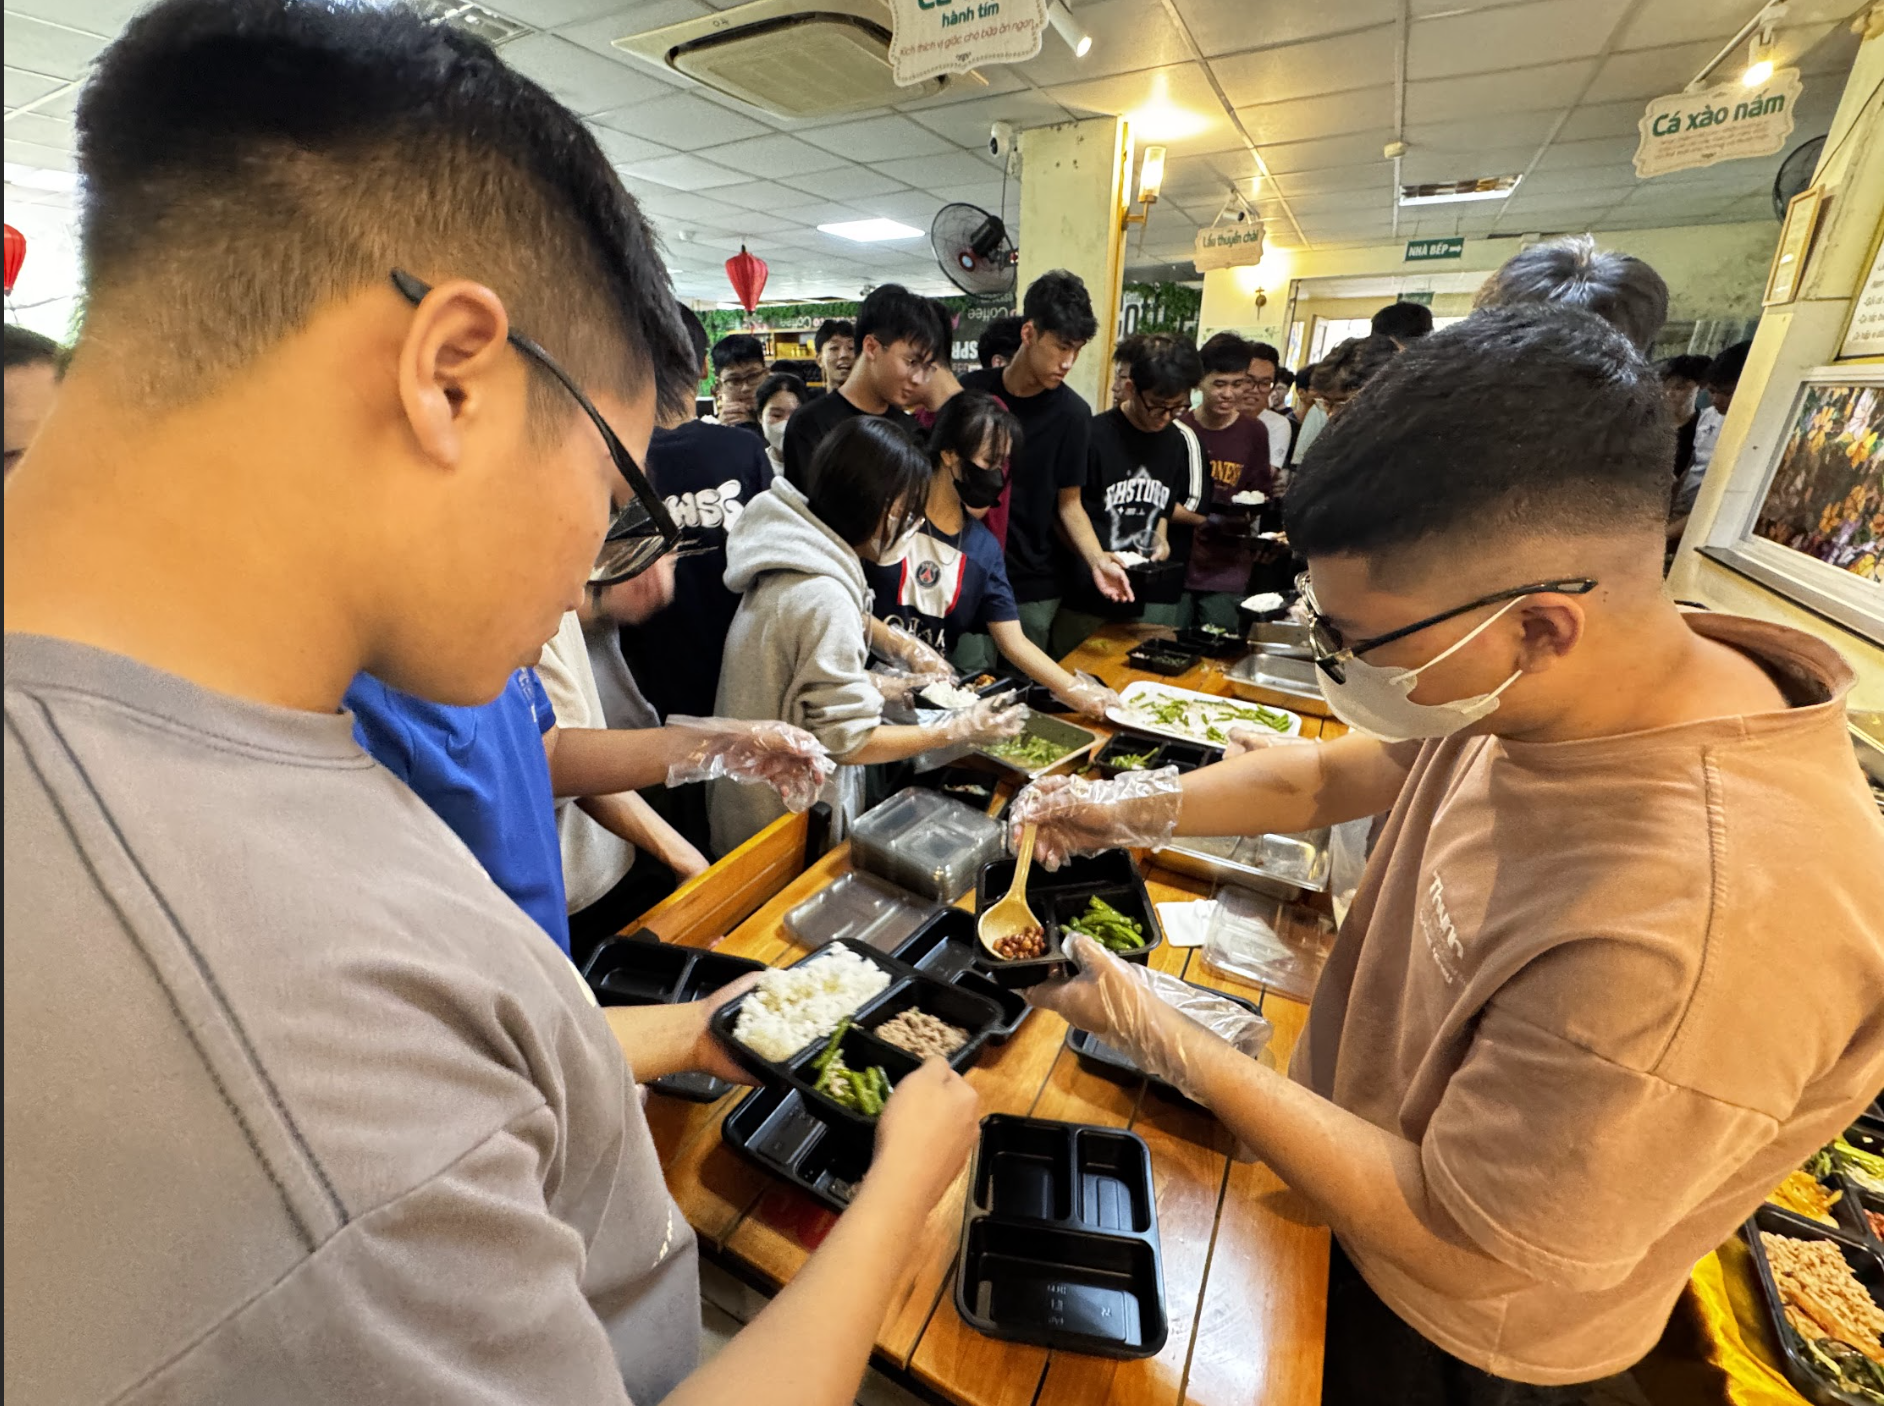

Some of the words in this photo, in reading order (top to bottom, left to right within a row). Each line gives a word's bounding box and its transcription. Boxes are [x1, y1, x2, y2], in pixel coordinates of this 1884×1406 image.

[942, 6, 975, 28] hành
[978, 2, 1000, 18] tím
[1652, 110, 1682, 138] Cá
[1685, 104, 1729, 132] xào
[1732, 88, 1786, 122] nấm
[1408, 243, 1428, 257] NHÀ
